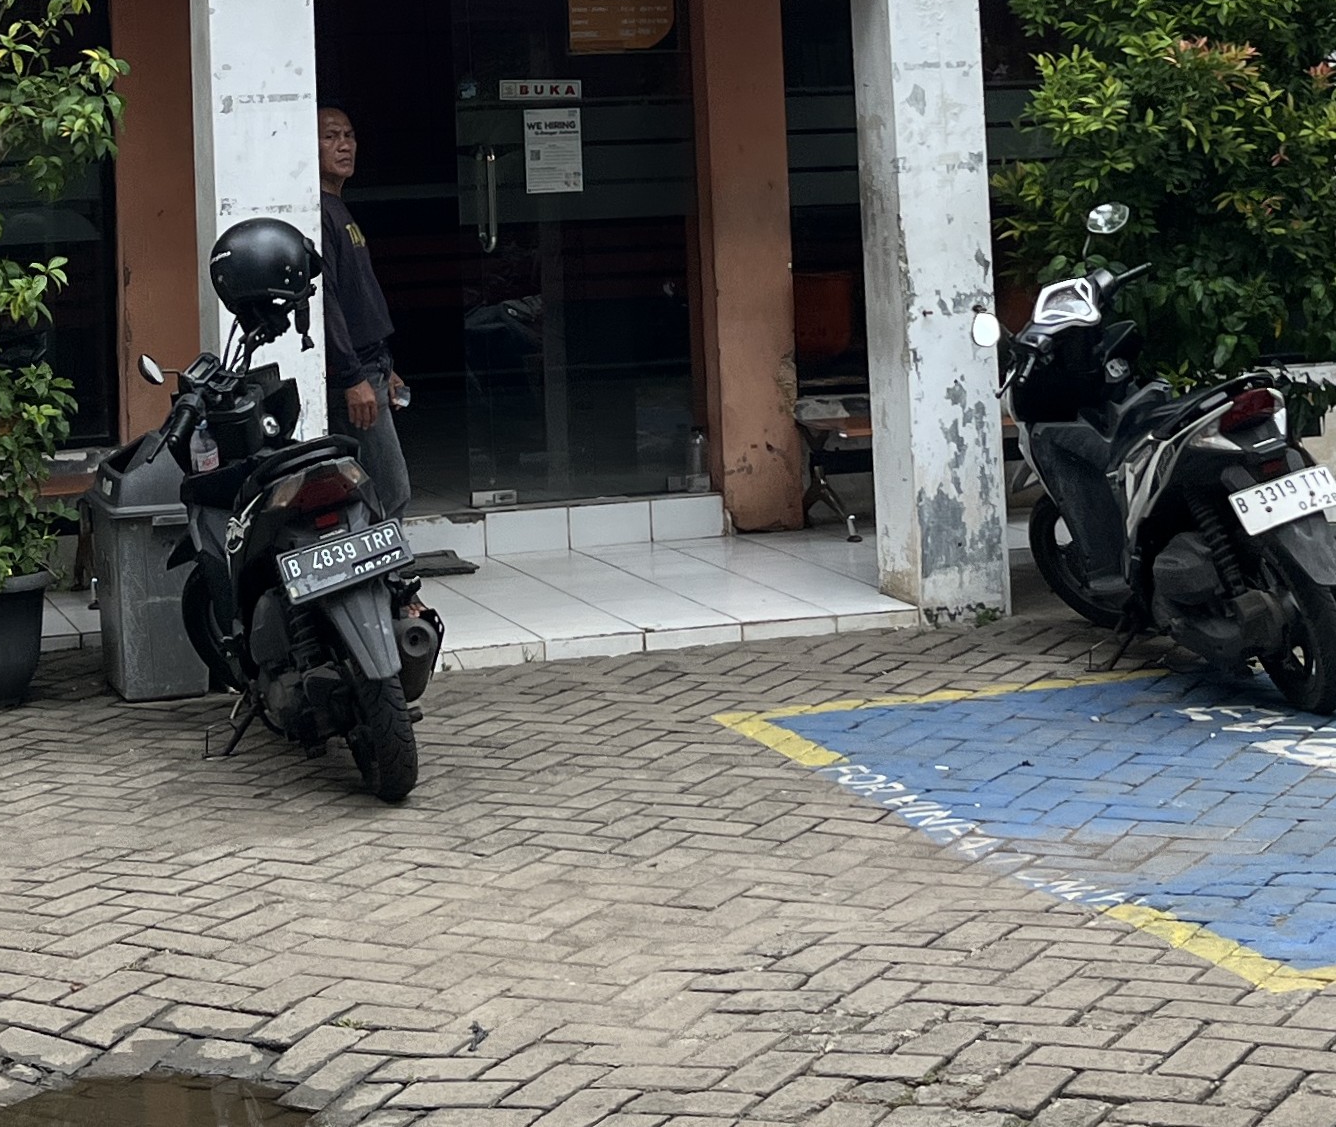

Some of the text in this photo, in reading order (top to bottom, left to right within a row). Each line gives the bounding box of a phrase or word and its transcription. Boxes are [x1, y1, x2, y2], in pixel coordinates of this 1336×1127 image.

[519, 84, 576, 96] BUKA
[526, 120, 576, 130] WE HIRING
[1234, 469, 1331, 514] B 3319 TTY
[287, 528, 395, 578] B 4839 TRP
[821, 764, 906, 796] FOR
